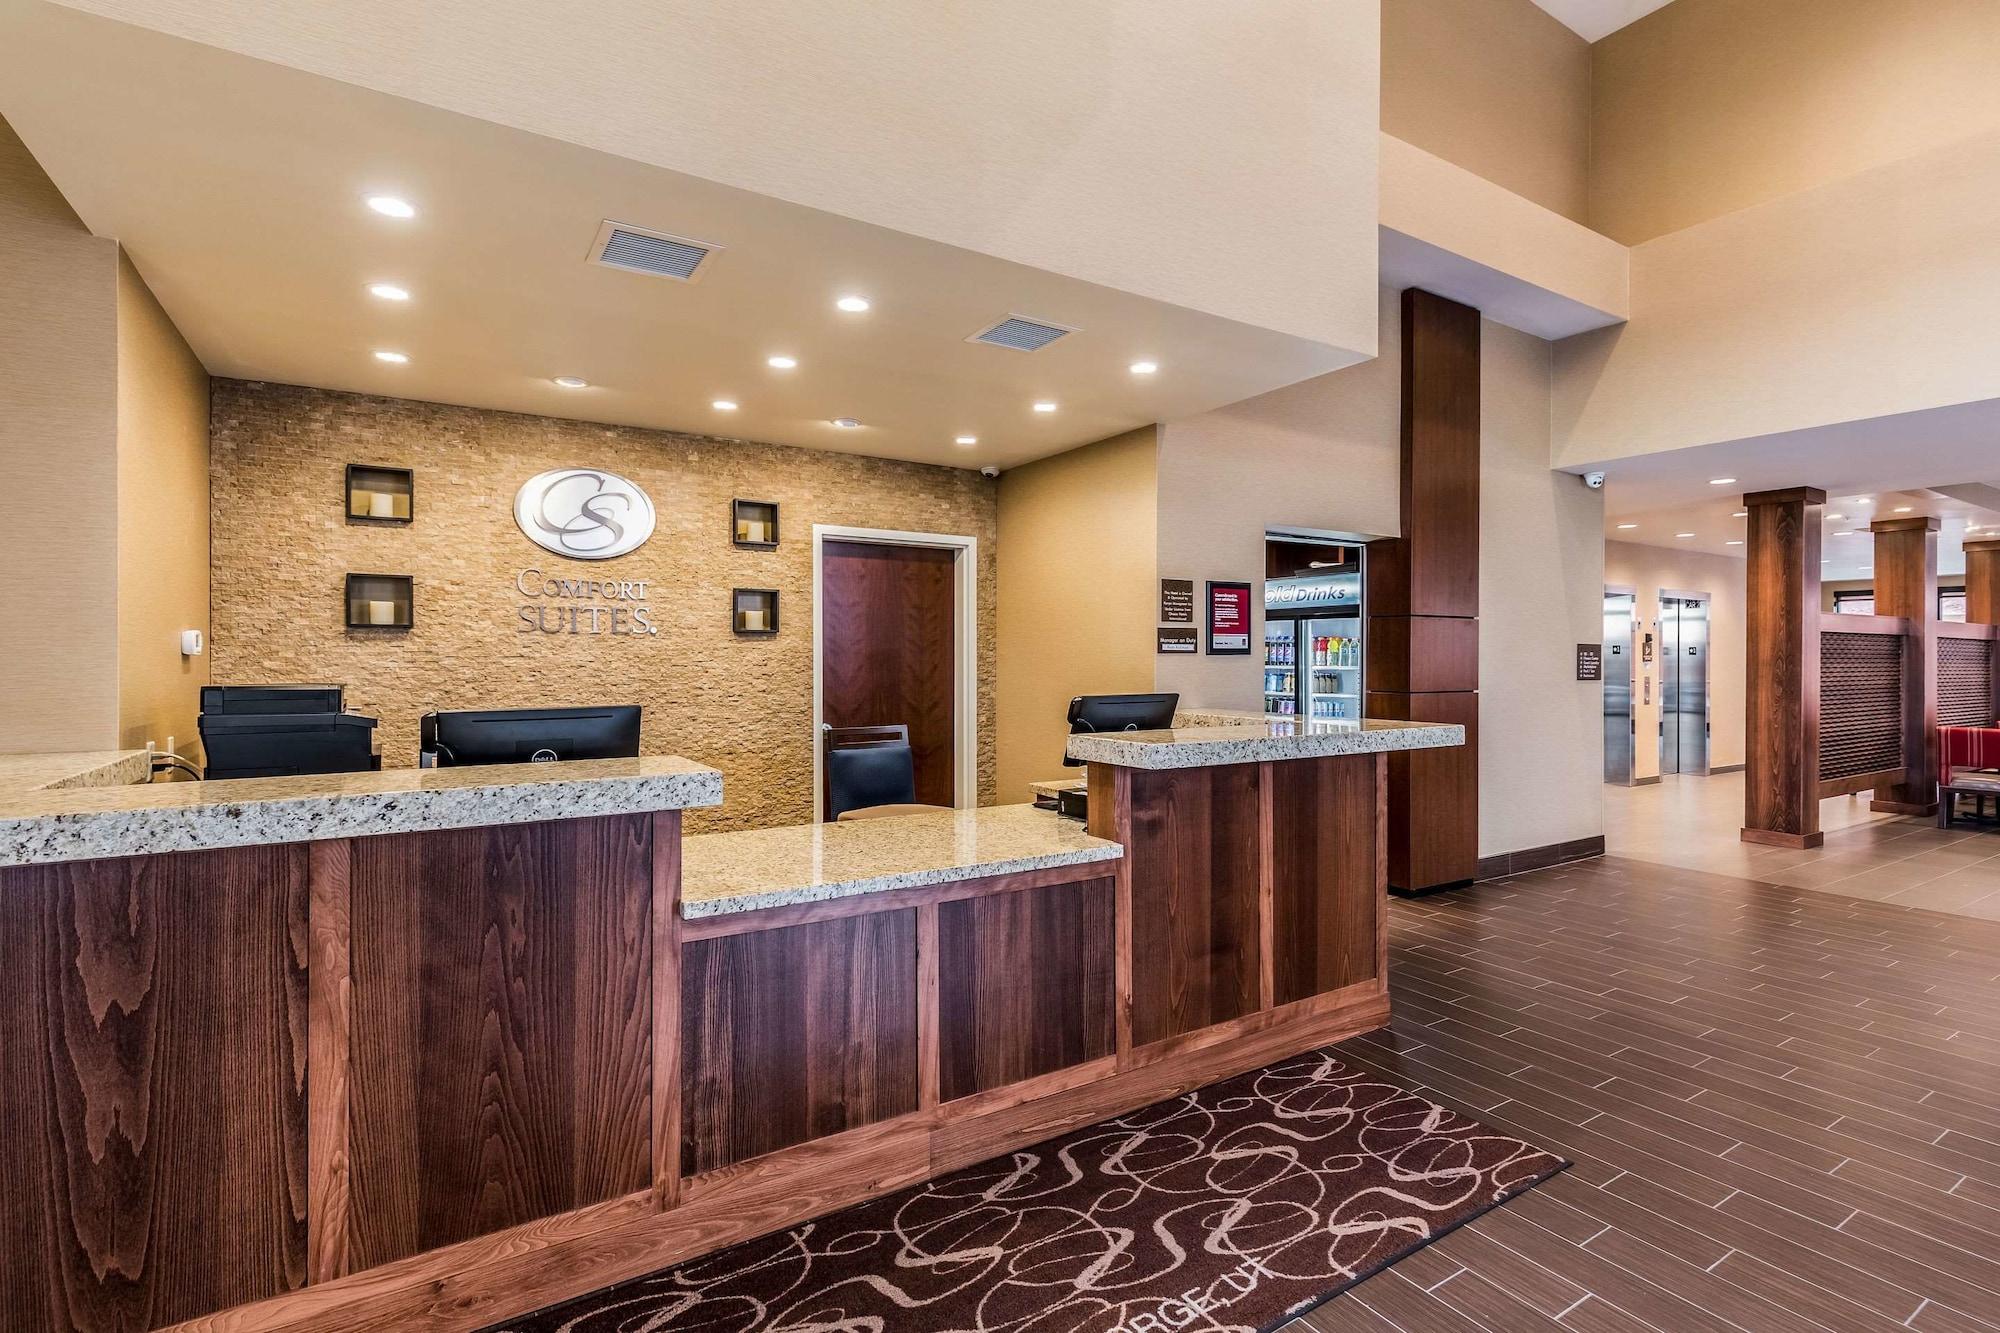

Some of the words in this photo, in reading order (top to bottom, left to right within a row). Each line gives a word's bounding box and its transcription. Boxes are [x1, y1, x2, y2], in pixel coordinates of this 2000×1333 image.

[1265, 585, 1296, 603] old
[1296, 586, 1346, 602] Drinks
[1221, 1257, 1275, 1291] UT
